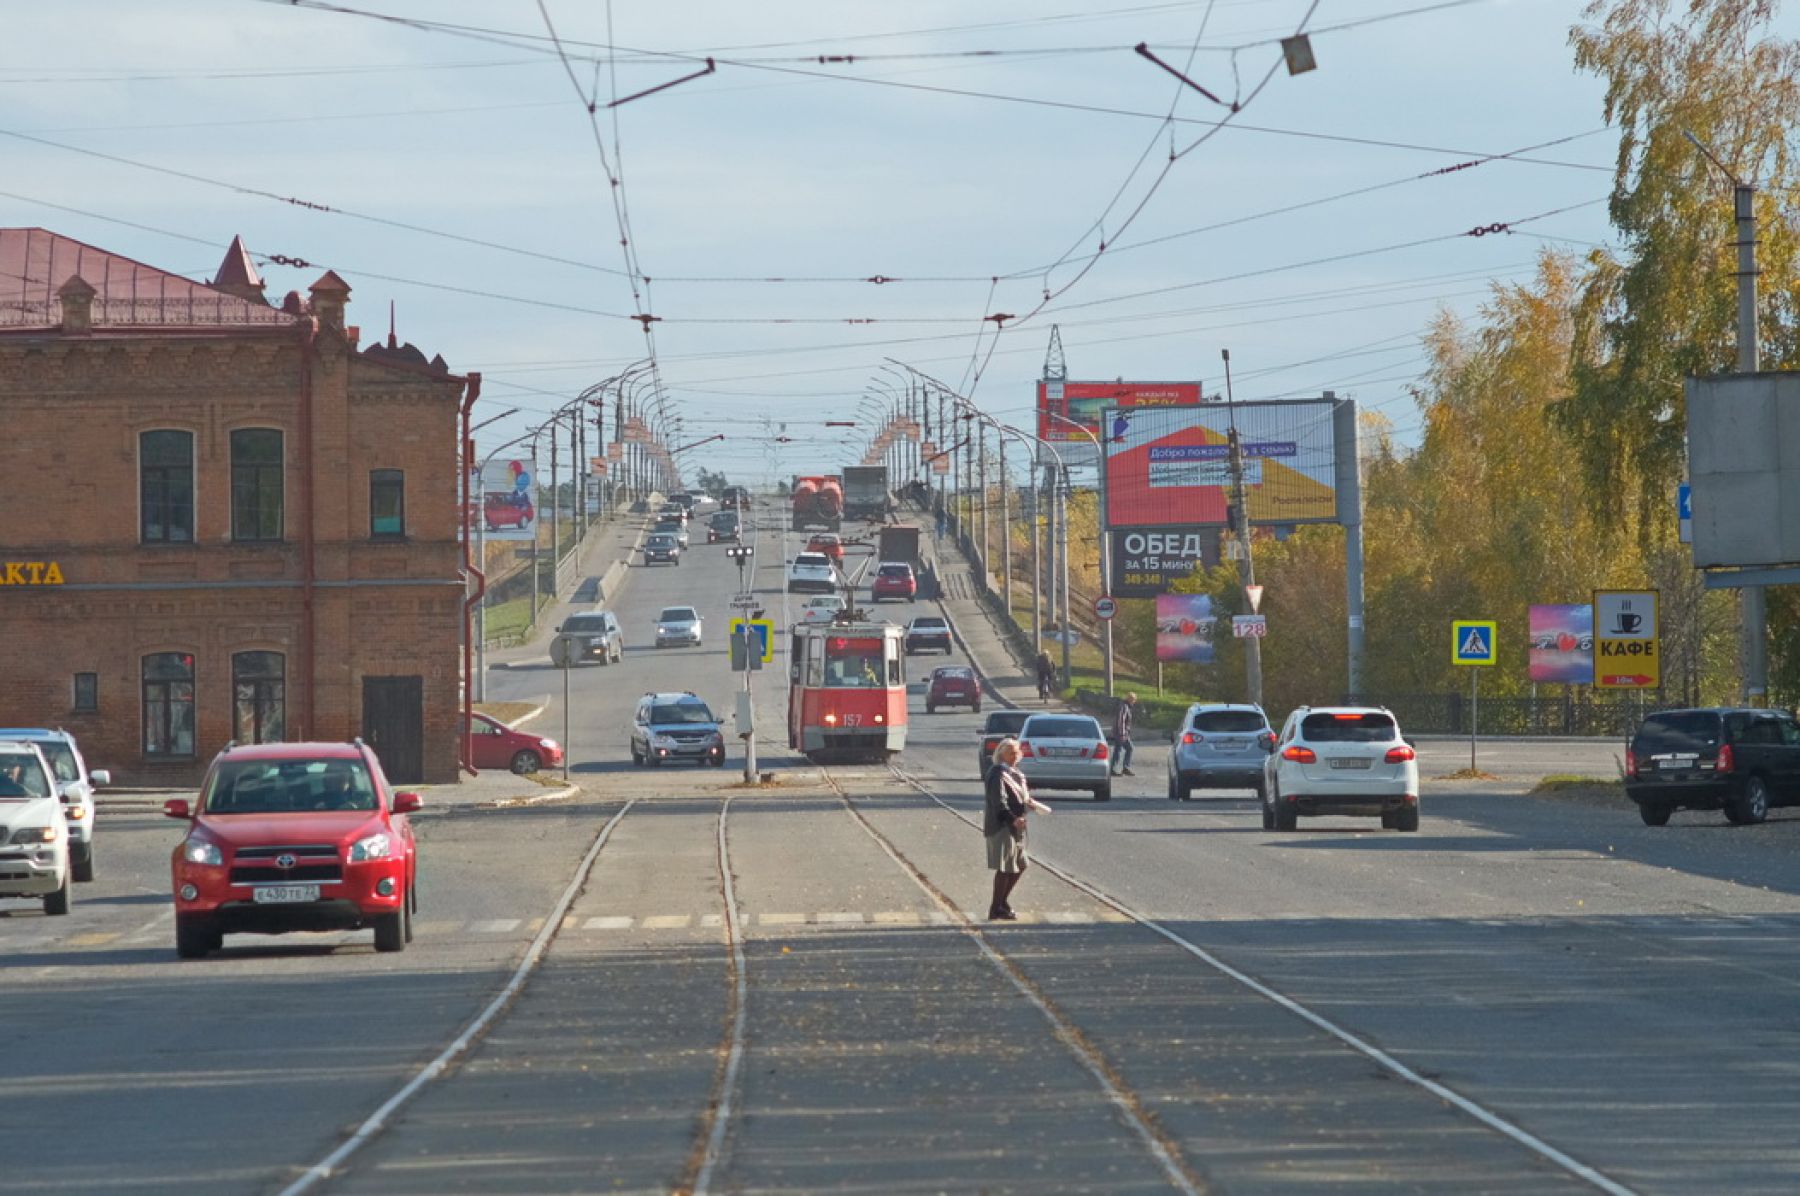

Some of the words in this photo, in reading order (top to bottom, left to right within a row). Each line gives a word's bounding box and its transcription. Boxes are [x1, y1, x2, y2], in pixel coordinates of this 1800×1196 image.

[1150, 448, 1185, 460] Добро
[1188, 446, 1248, 458] пожалоь
[1125, 533, 1202, 558] ОБЕД
[1125, 560, 1140, 570] ЗА
[1142, 556, 1160, 570] 15
[1162, 560, 1195, 570] МИНУ
[0, 561, 65, 585] КТА
[1234, 624, 1264, 637] 128
[1601, 641, 1654, 657] КАФЕ
[844, 713, 863, 727] 157
